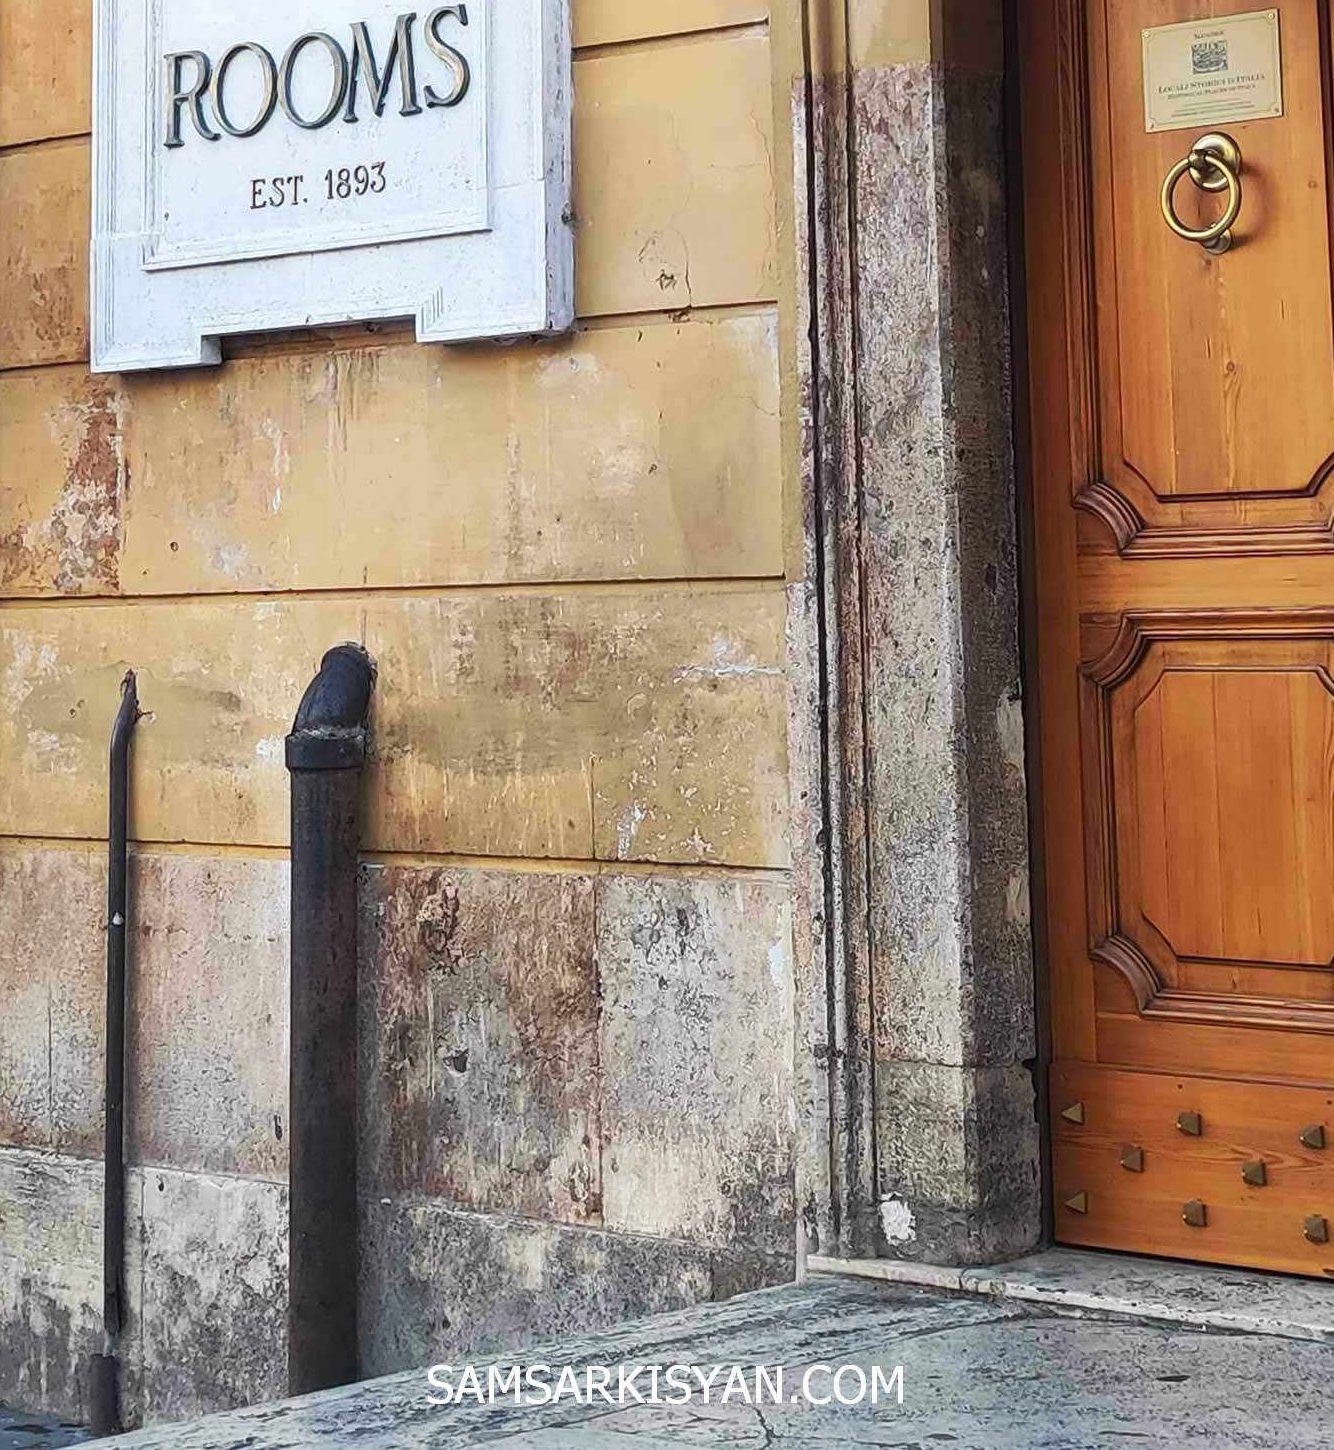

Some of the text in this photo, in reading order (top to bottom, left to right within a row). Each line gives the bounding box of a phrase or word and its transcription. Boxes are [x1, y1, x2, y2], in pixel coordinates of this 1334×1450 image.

[163, 4, 471, 149] ROOMS
[250, 161, 387, 210] EST. 1893
